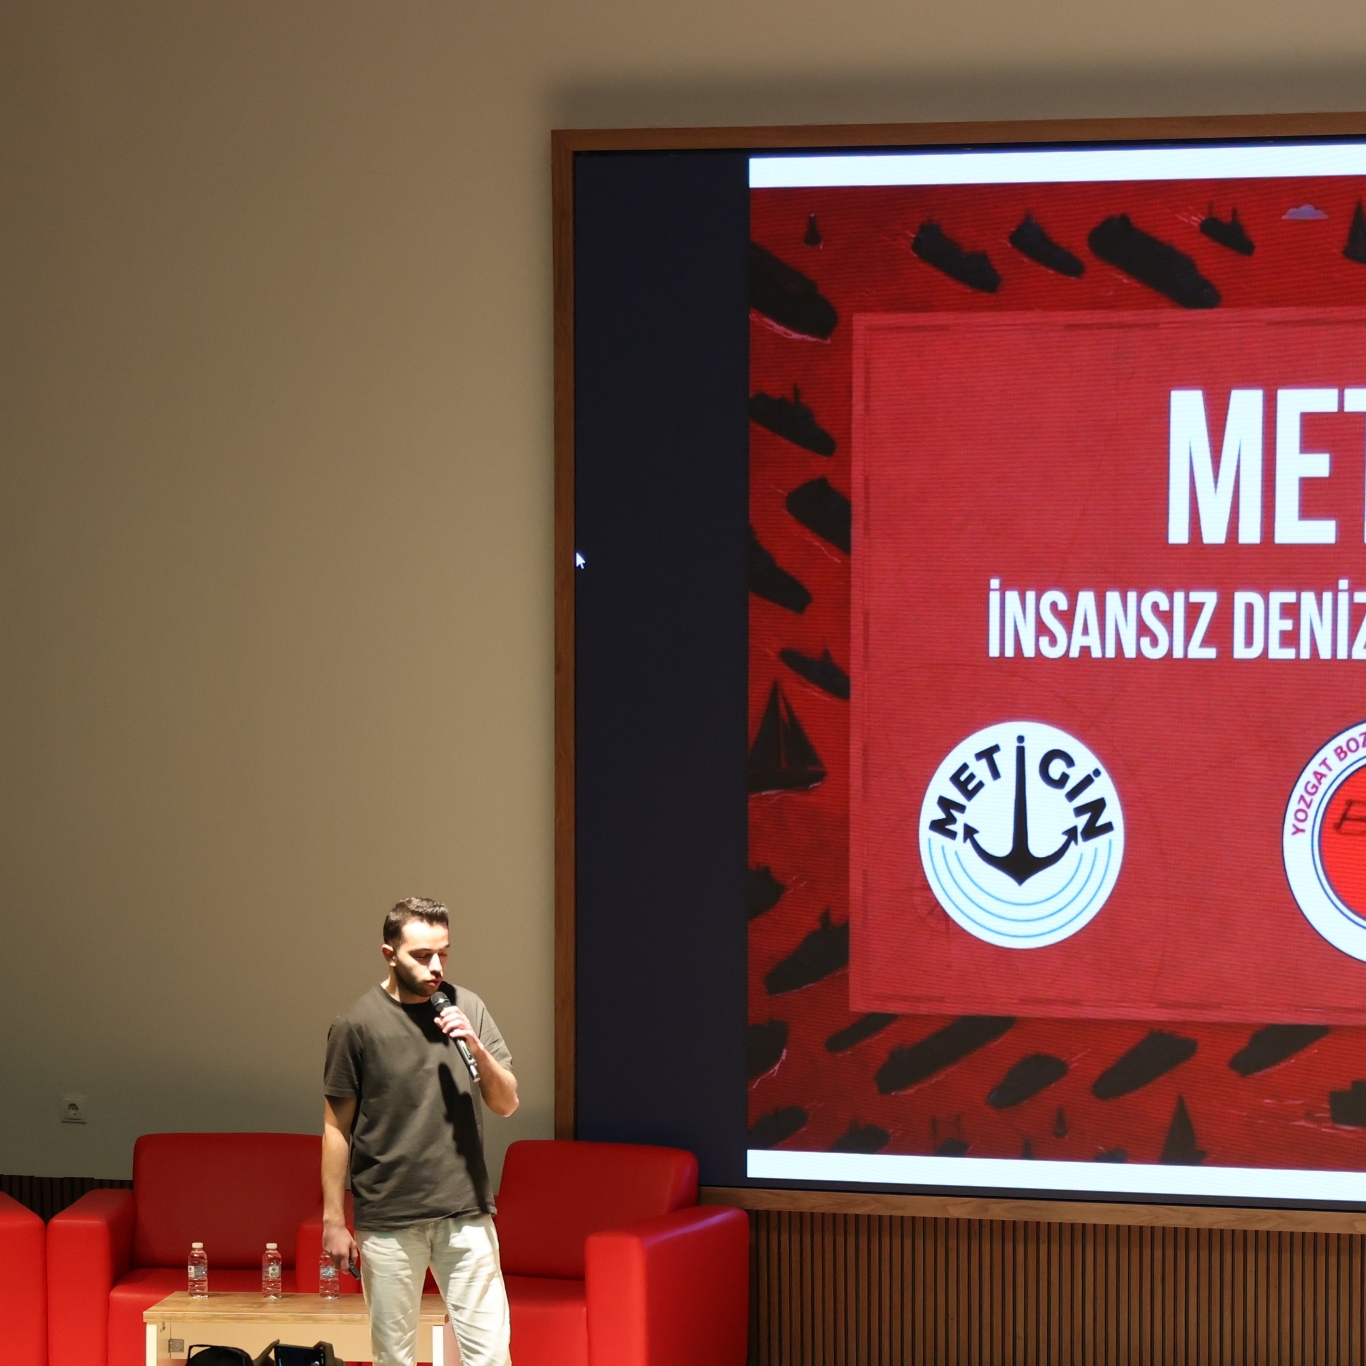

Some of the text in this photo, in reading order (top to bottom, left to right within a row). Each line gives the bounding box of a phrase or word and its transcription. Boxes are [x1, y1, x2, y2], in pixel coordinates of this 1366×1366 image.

[987, 579, 1218, 660] İNSANSIZ
[928, 734, 1115, 843] METİGİN
[1291, 757, 1333, 836] YOZGAT
